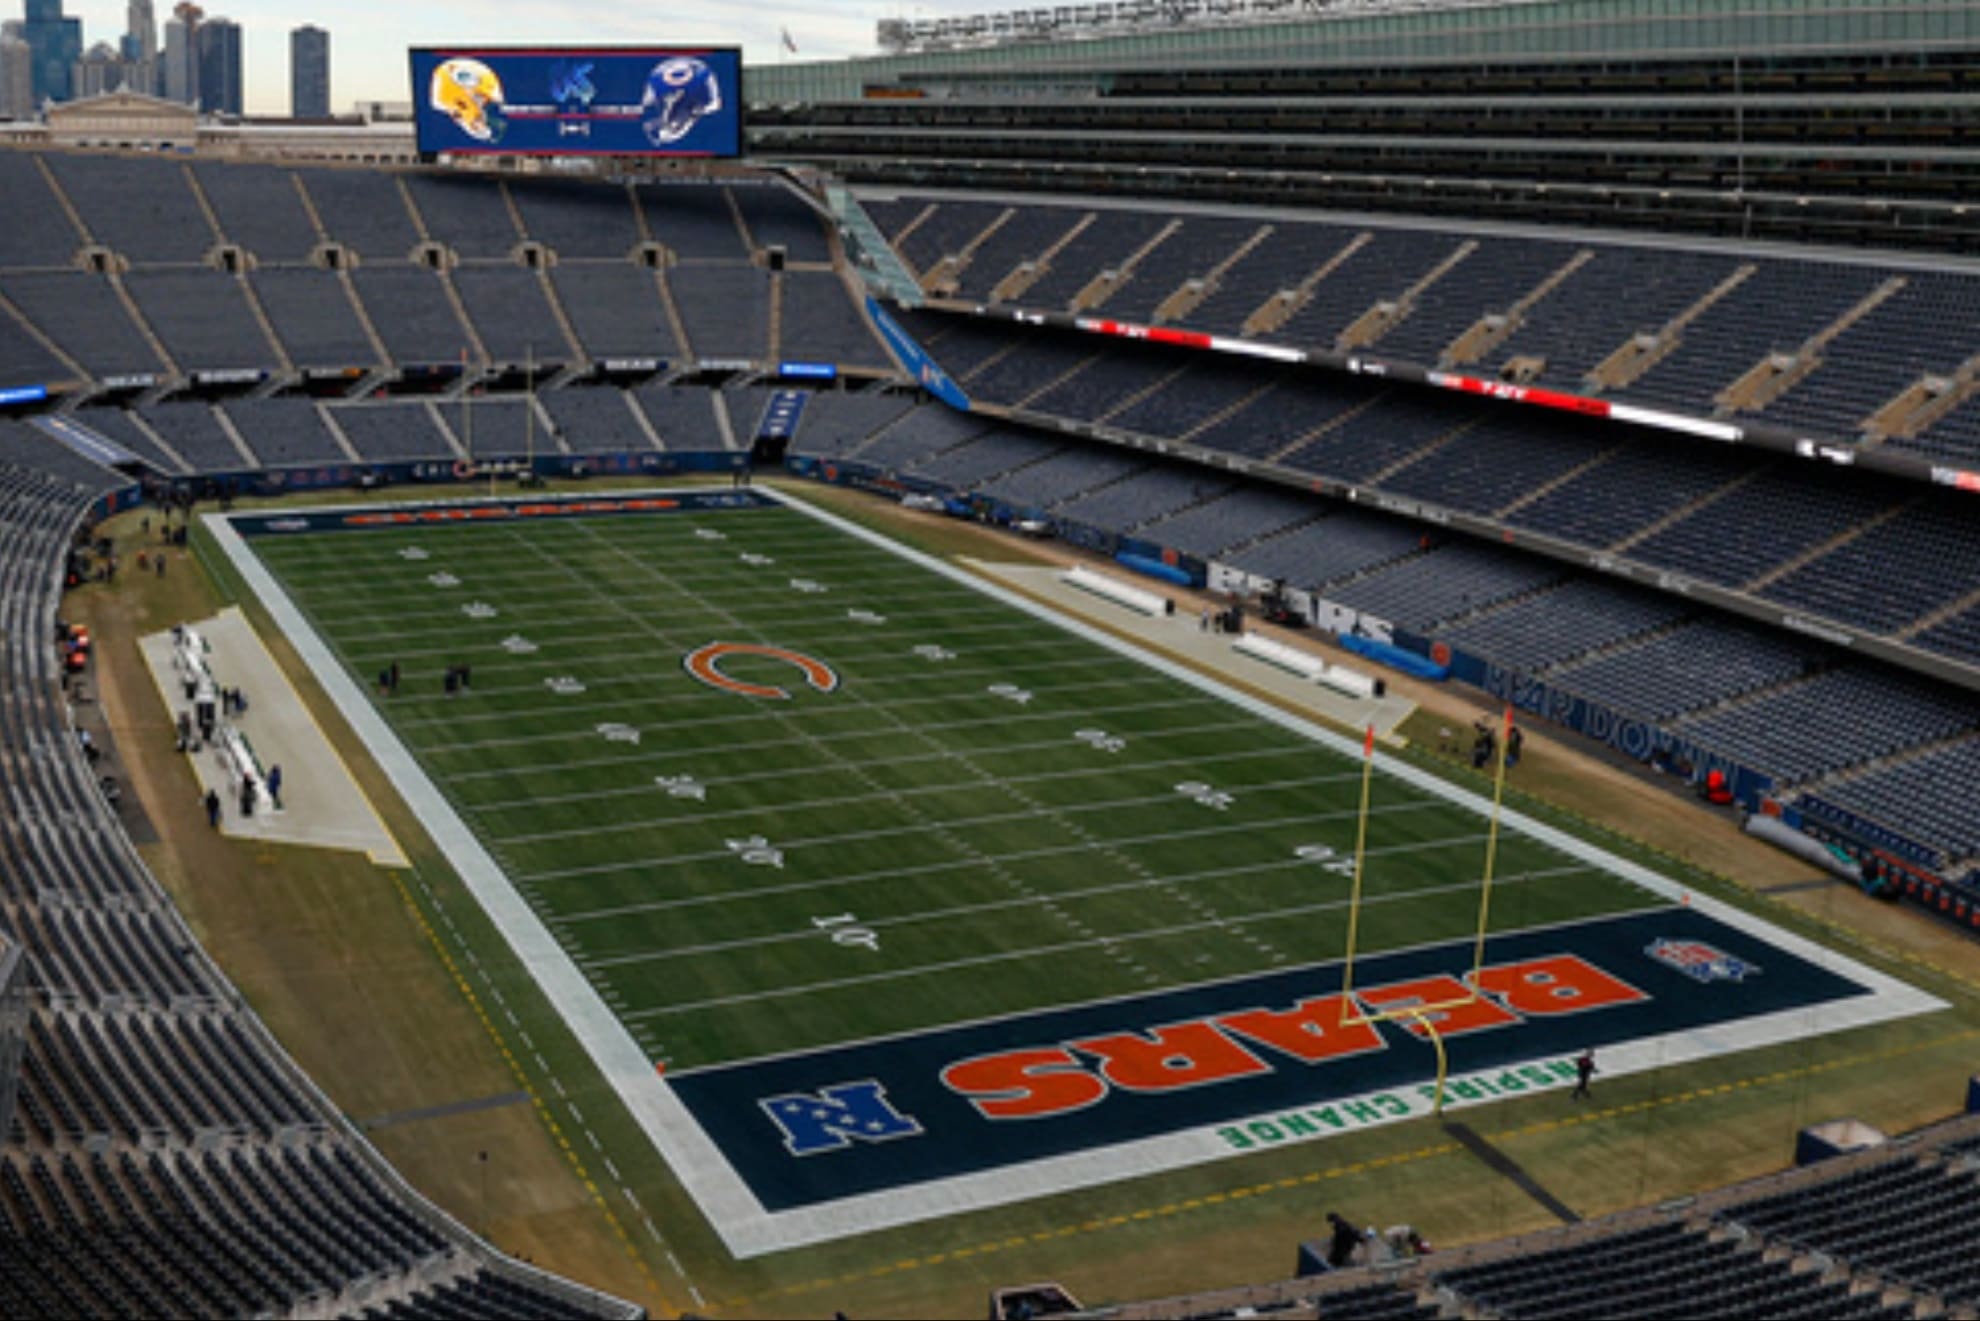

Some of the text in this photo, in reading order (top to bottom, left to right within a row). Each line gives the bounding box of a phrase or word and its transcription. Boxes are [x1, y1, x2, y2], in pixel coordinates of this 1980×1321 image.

[811, 912, 879, 949] 10
[940, 953, 1653, 1121] BEARS
[1215, 1056, 1590, 1150] NSPIRE CHANGE
